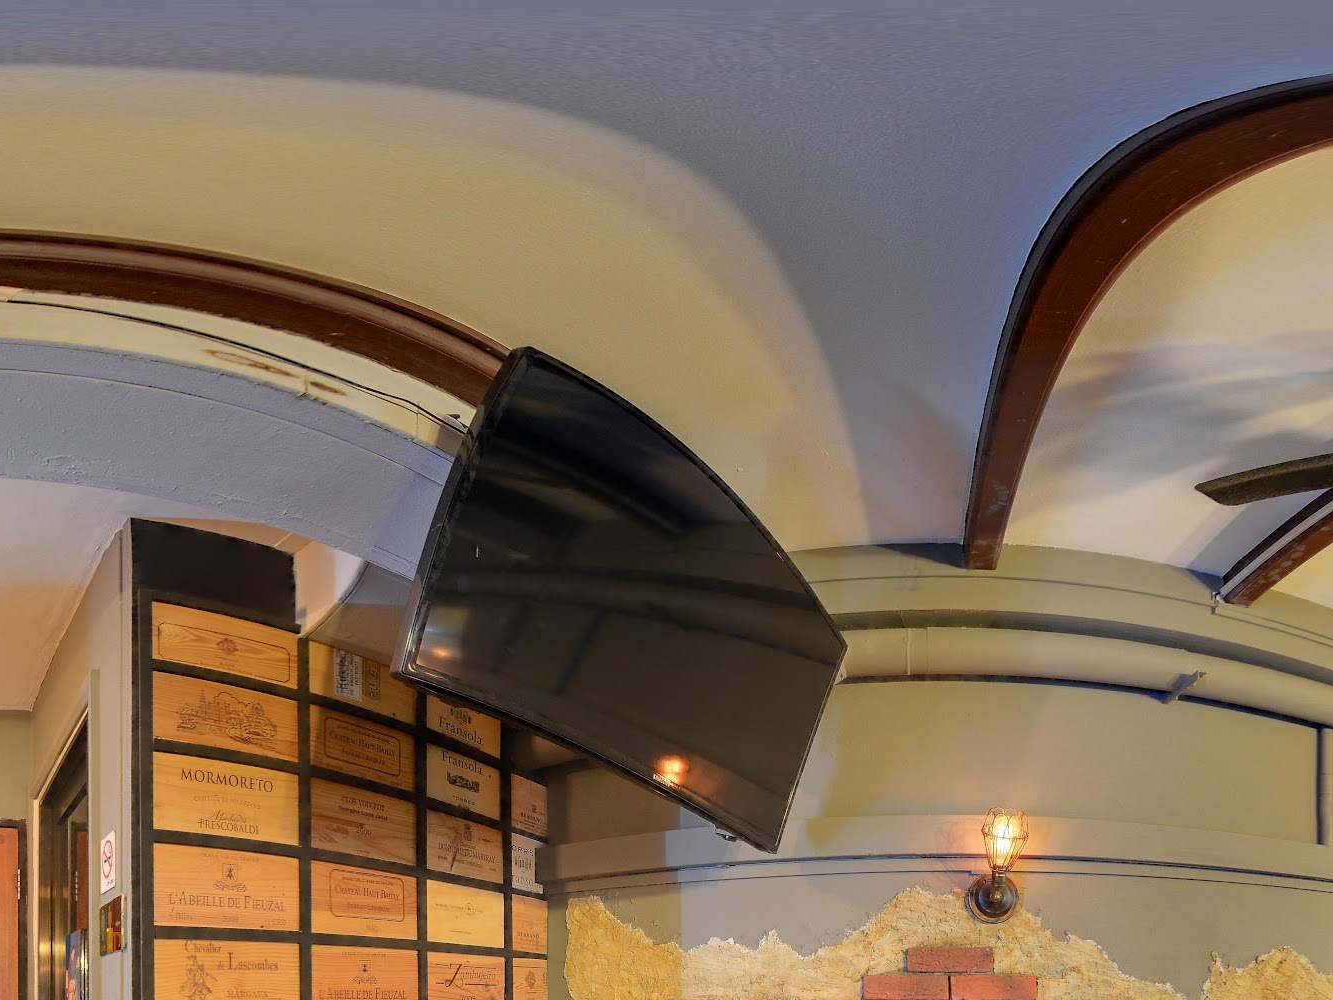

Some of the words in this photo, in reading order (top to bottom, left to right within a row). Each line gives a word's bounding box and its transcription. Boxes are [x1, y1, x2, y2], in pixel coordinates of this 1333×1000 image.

[439, 715, 482, 745] Fransola
[442, 750, 482, 775] Fransola
[180, 768, 274, 793] MORMORETO
[198, 818, 259, 835] FRESCOBALDI
[169, 891, 225, 908] L'ABEILLE
[227, 897, 241, 909] DE
[244, 895, 286, 912] FIEUZAL
[222, 915, 239, 923] 2009
[184, 939, 222, 953] Chevalier
[217, 962, 225, 971] de
[228, 952, 279, 971] Lascombes
[226, 989, 269, 998] MARGAUX
[319, 988, 361, 1000] L'ABEILLE
[363, 990, 374, 1000] DE
[375, 988, 407, 1000] FIEUZAL
